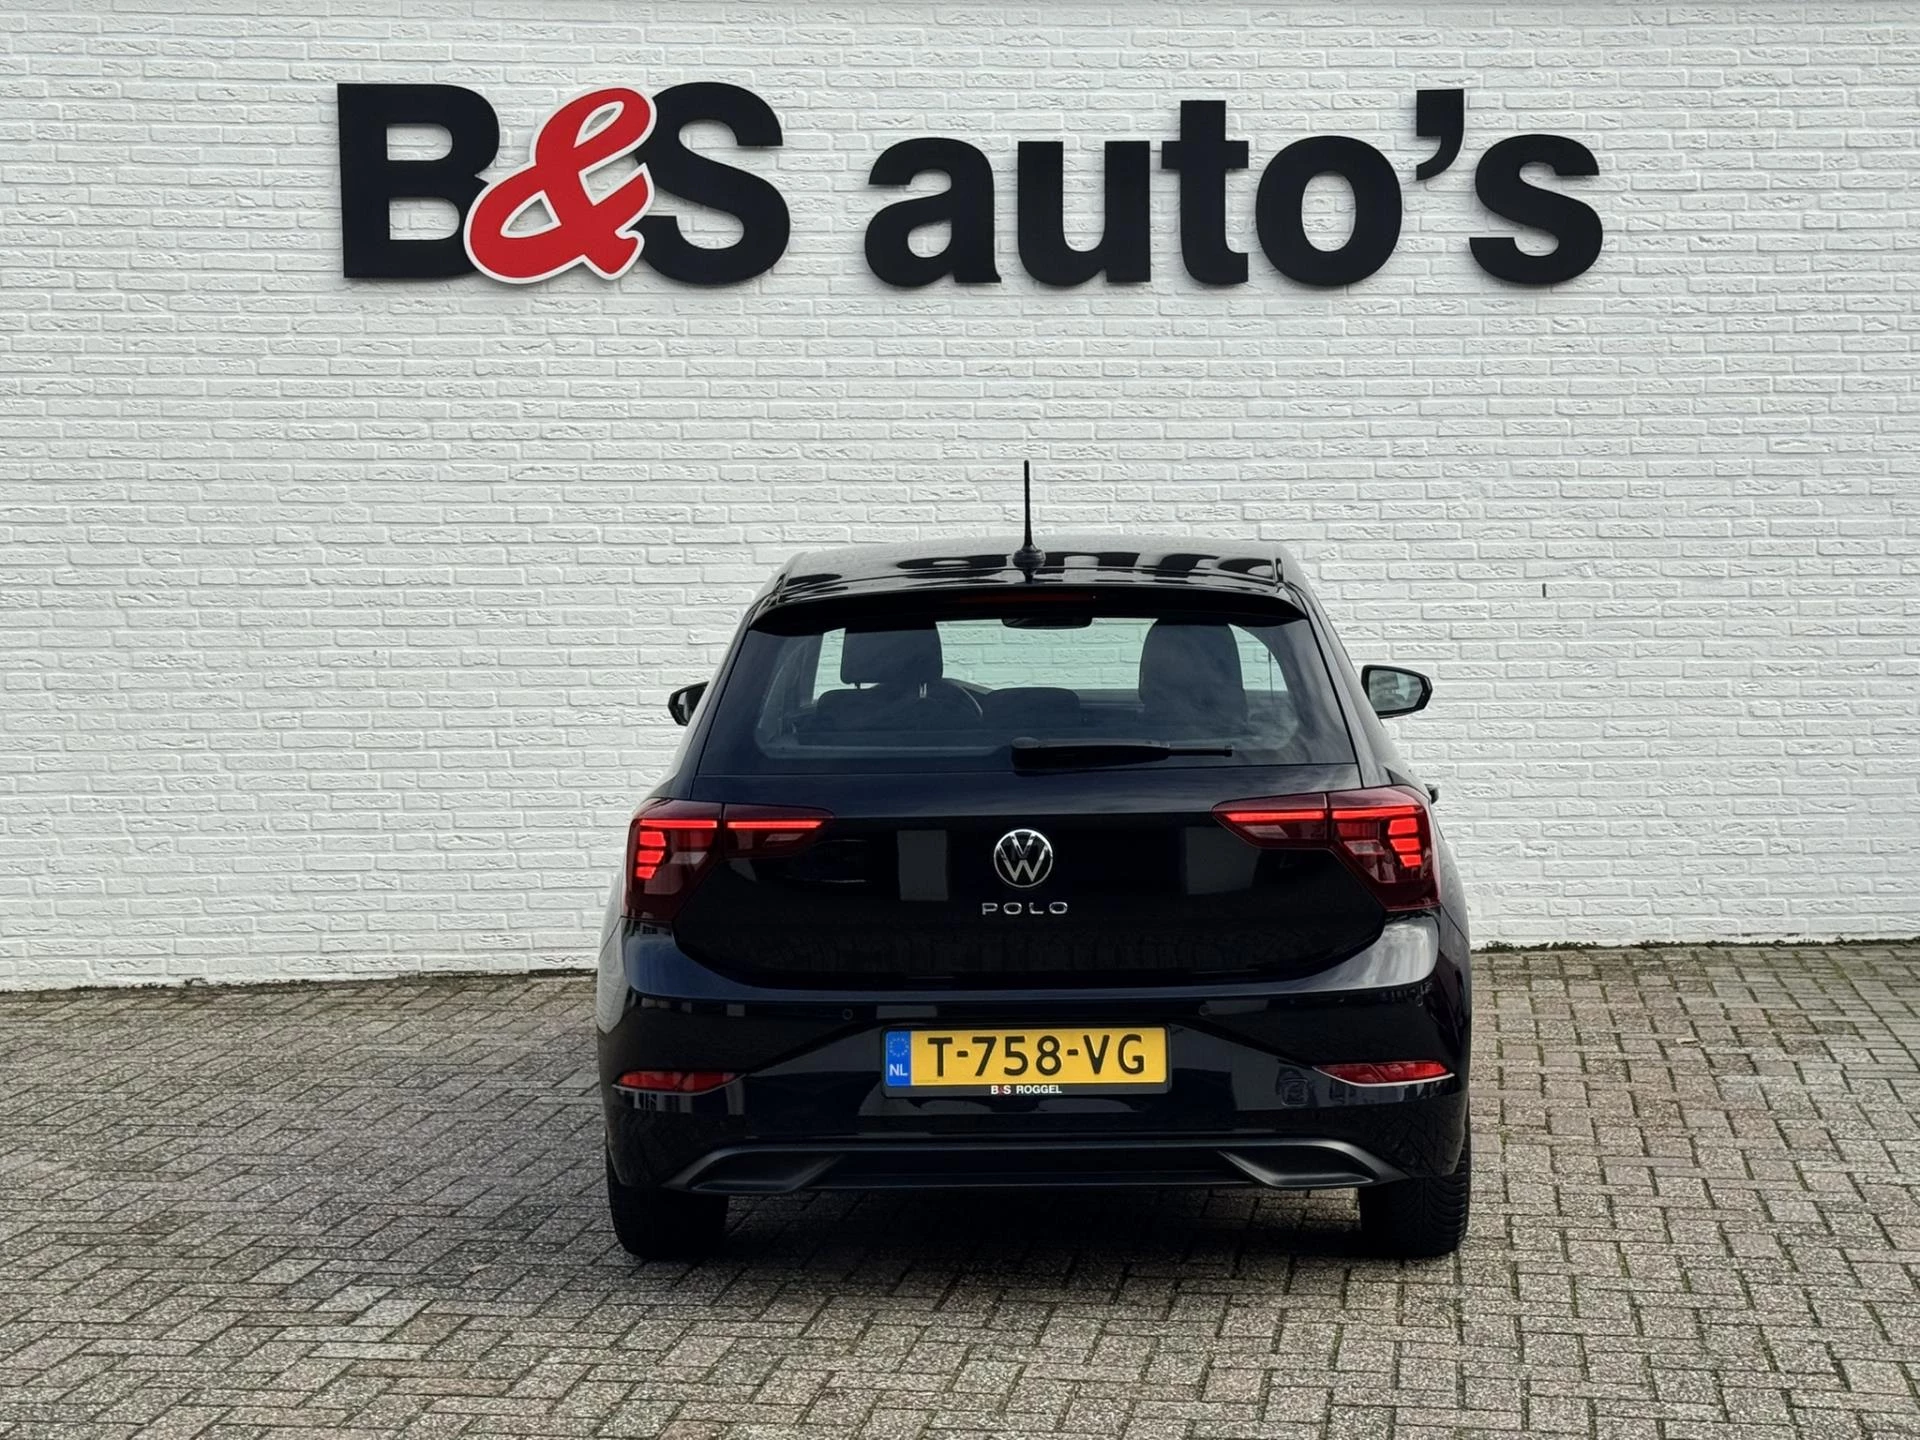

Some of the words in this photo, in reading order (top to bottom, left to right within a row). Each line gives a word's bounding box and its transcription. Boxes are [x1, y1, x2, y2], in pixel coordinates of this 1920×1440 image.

[338, 82, 791, 288] B&S
[865, 88, 1603, 290] auto's
[981, 902, 1069, 915] POLO
[889, 1064, 909, 1077] NL
[927, 1034, 1146, 1077] T-758-VG
[1016, 1085, 1063, 1094] ROGGEL
